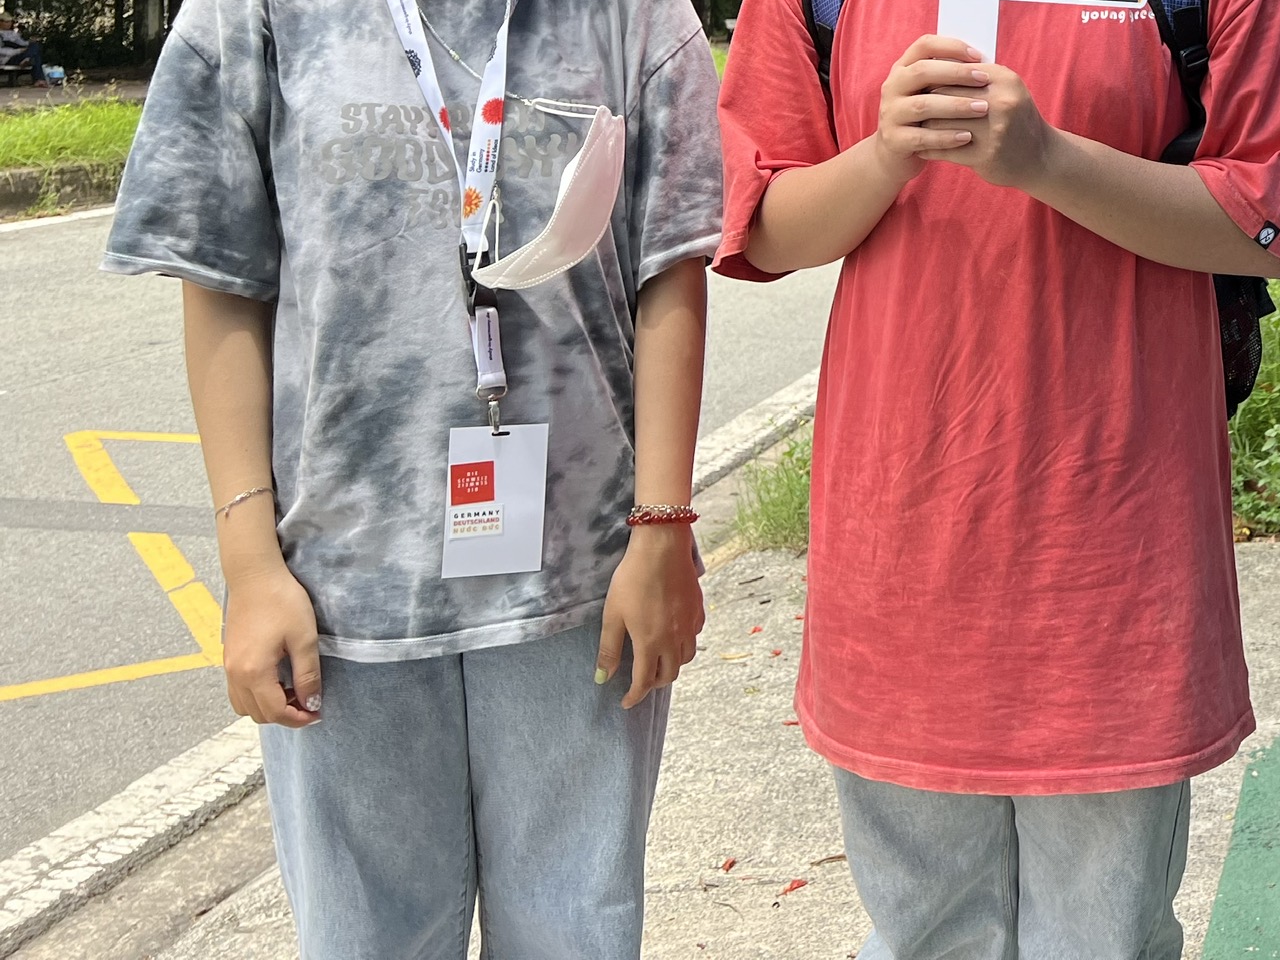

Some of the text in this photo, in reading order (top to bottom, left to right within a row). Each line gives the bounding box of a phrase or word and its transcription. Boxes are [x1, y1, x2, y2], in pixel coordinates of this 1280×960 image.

[1081, 9, 1126, 23] young
[453, 509, 500, 519] GERMANY
[453, 517, 500, 527] DEUTSCHLAND
